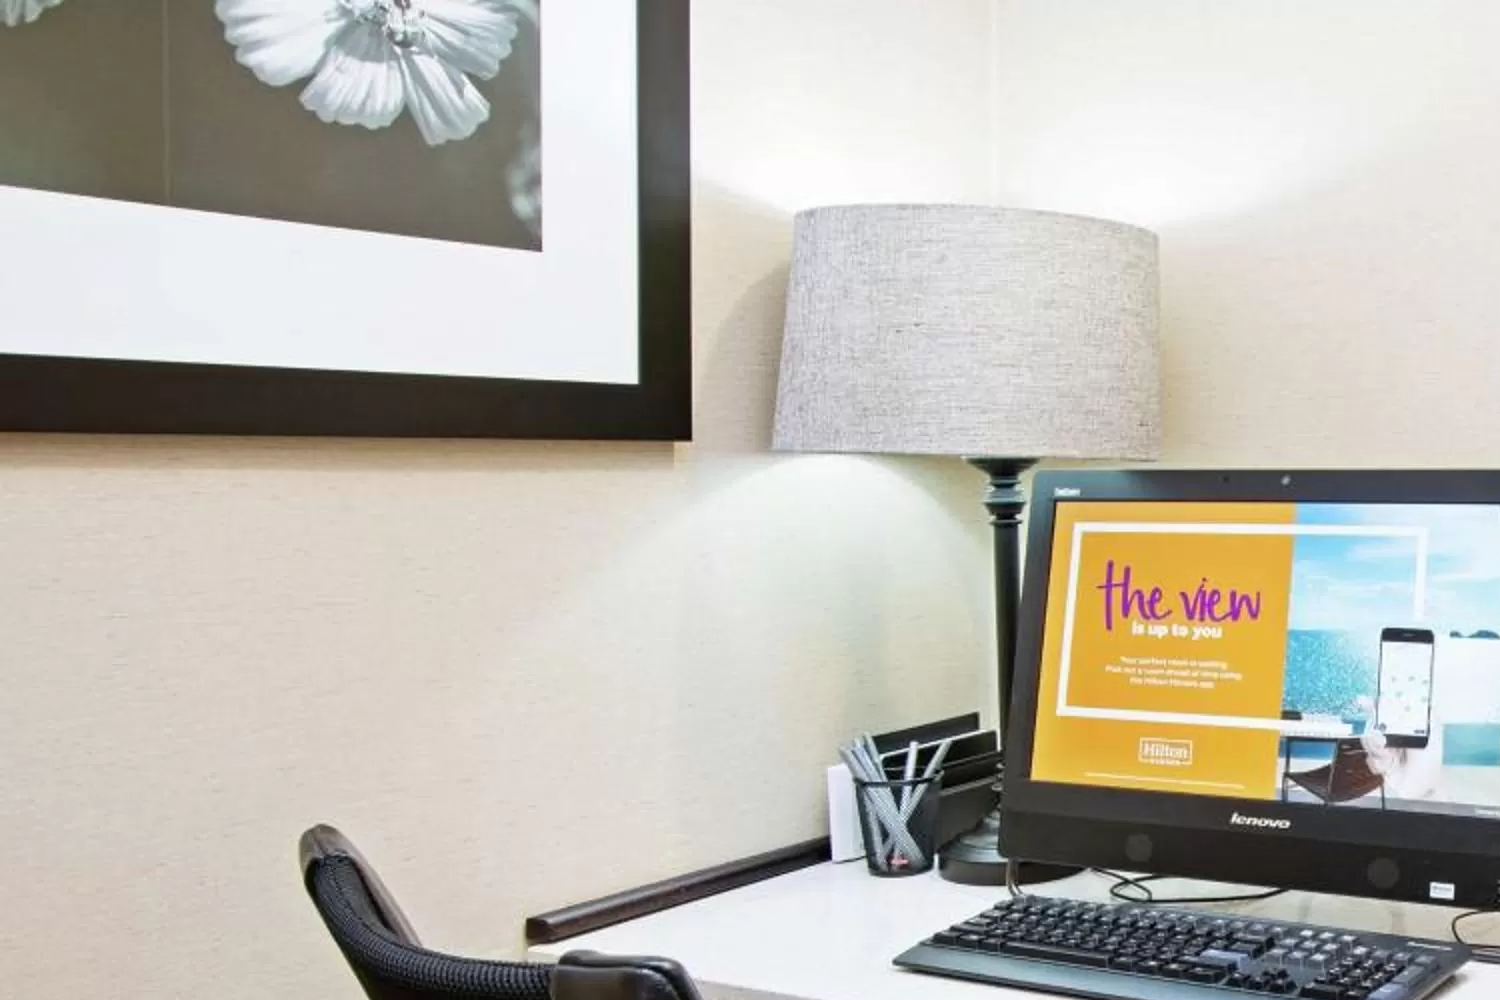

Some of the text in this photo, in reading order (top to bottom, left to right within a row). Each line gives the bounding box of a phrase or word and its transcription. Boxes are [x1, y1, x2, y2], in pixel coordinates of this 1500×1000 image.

[1097, 560, 1261, 631] the view
[1131, 619, 1223, 641] is up to you
[1143, 742, 1187, 759] Hilton
[1231, 812, 1291, 829] lenovo
